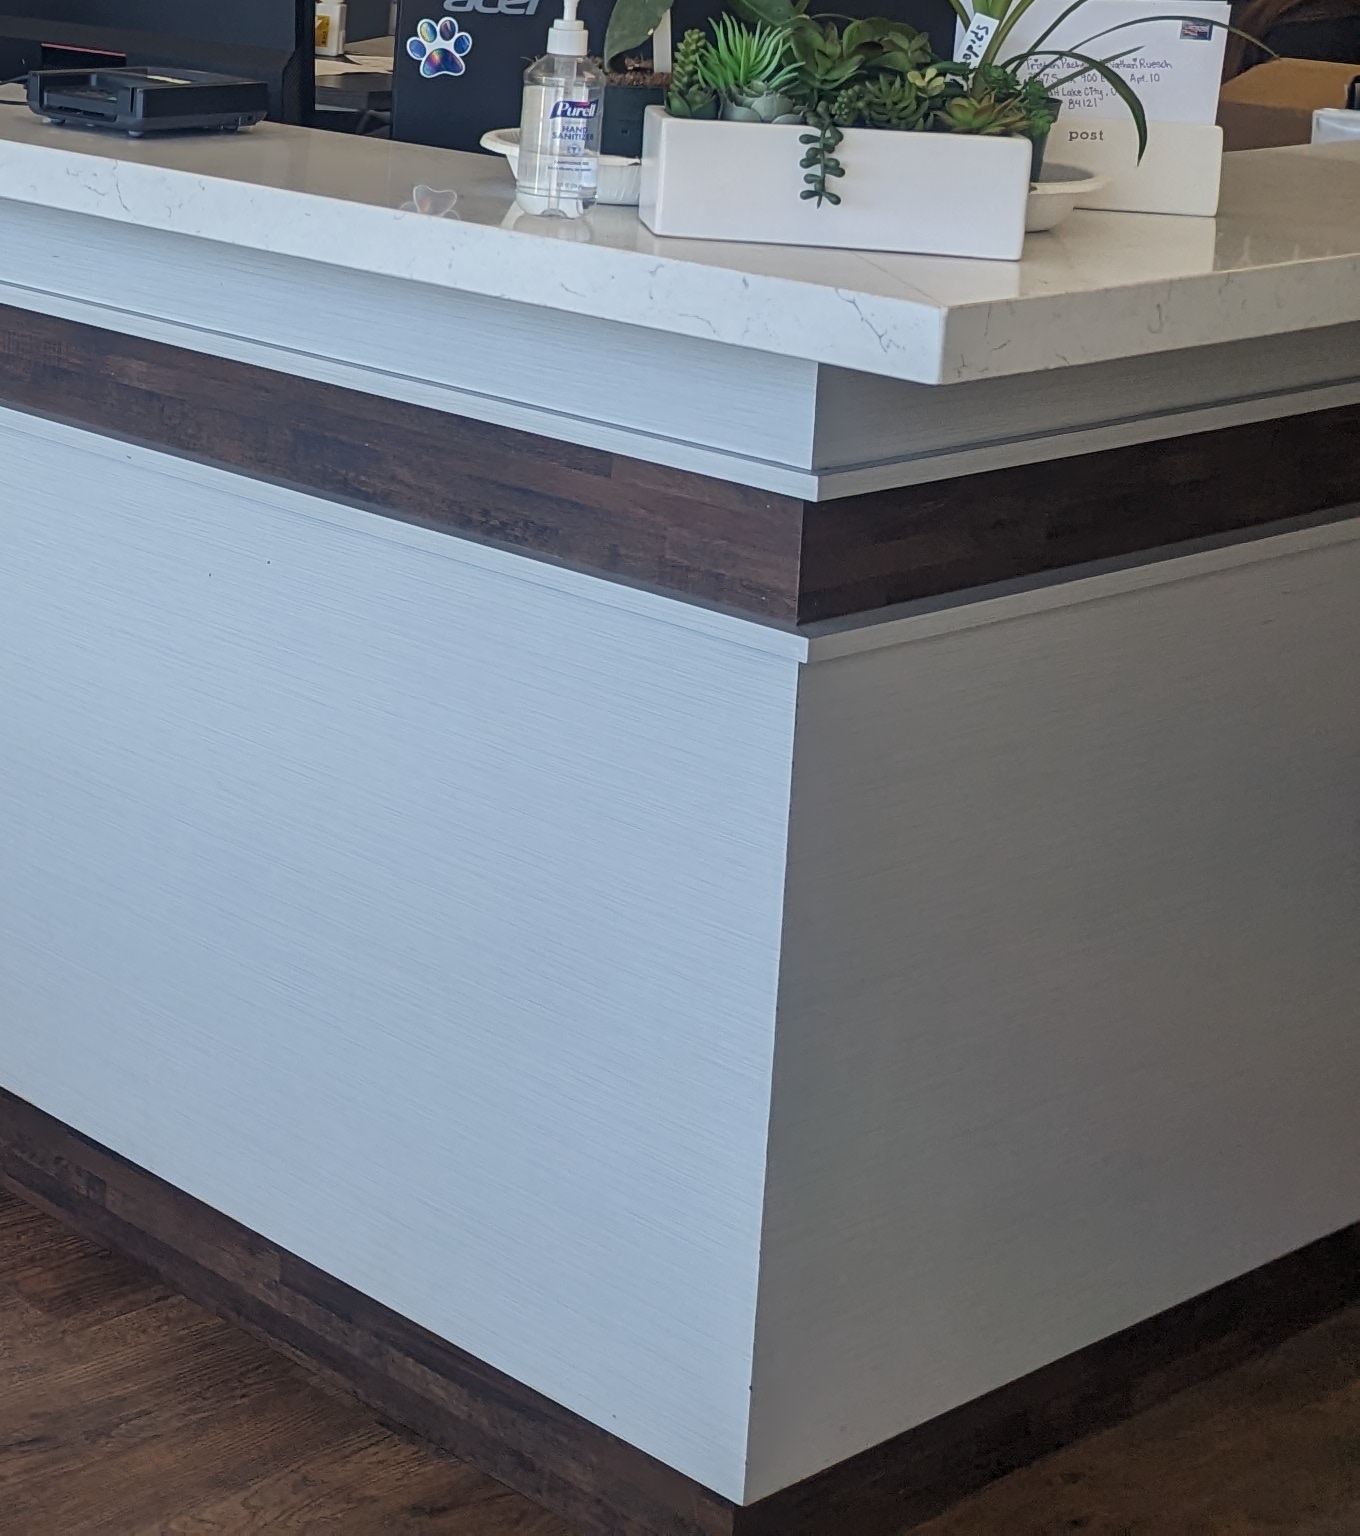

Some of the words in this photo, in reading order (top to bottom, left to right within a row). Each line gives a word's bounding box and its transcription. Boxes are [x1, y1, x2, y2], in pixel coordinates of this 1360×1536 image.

[962, 24, 989, 67] Spide
[1061, 88, 1082, 97] Lake
[556, 102, 596, 118] Purell
[1068, 97, 1097, 110] 84121
[561, 125, 589, 134] HAND
[1068, 129, 1104, 142] post
